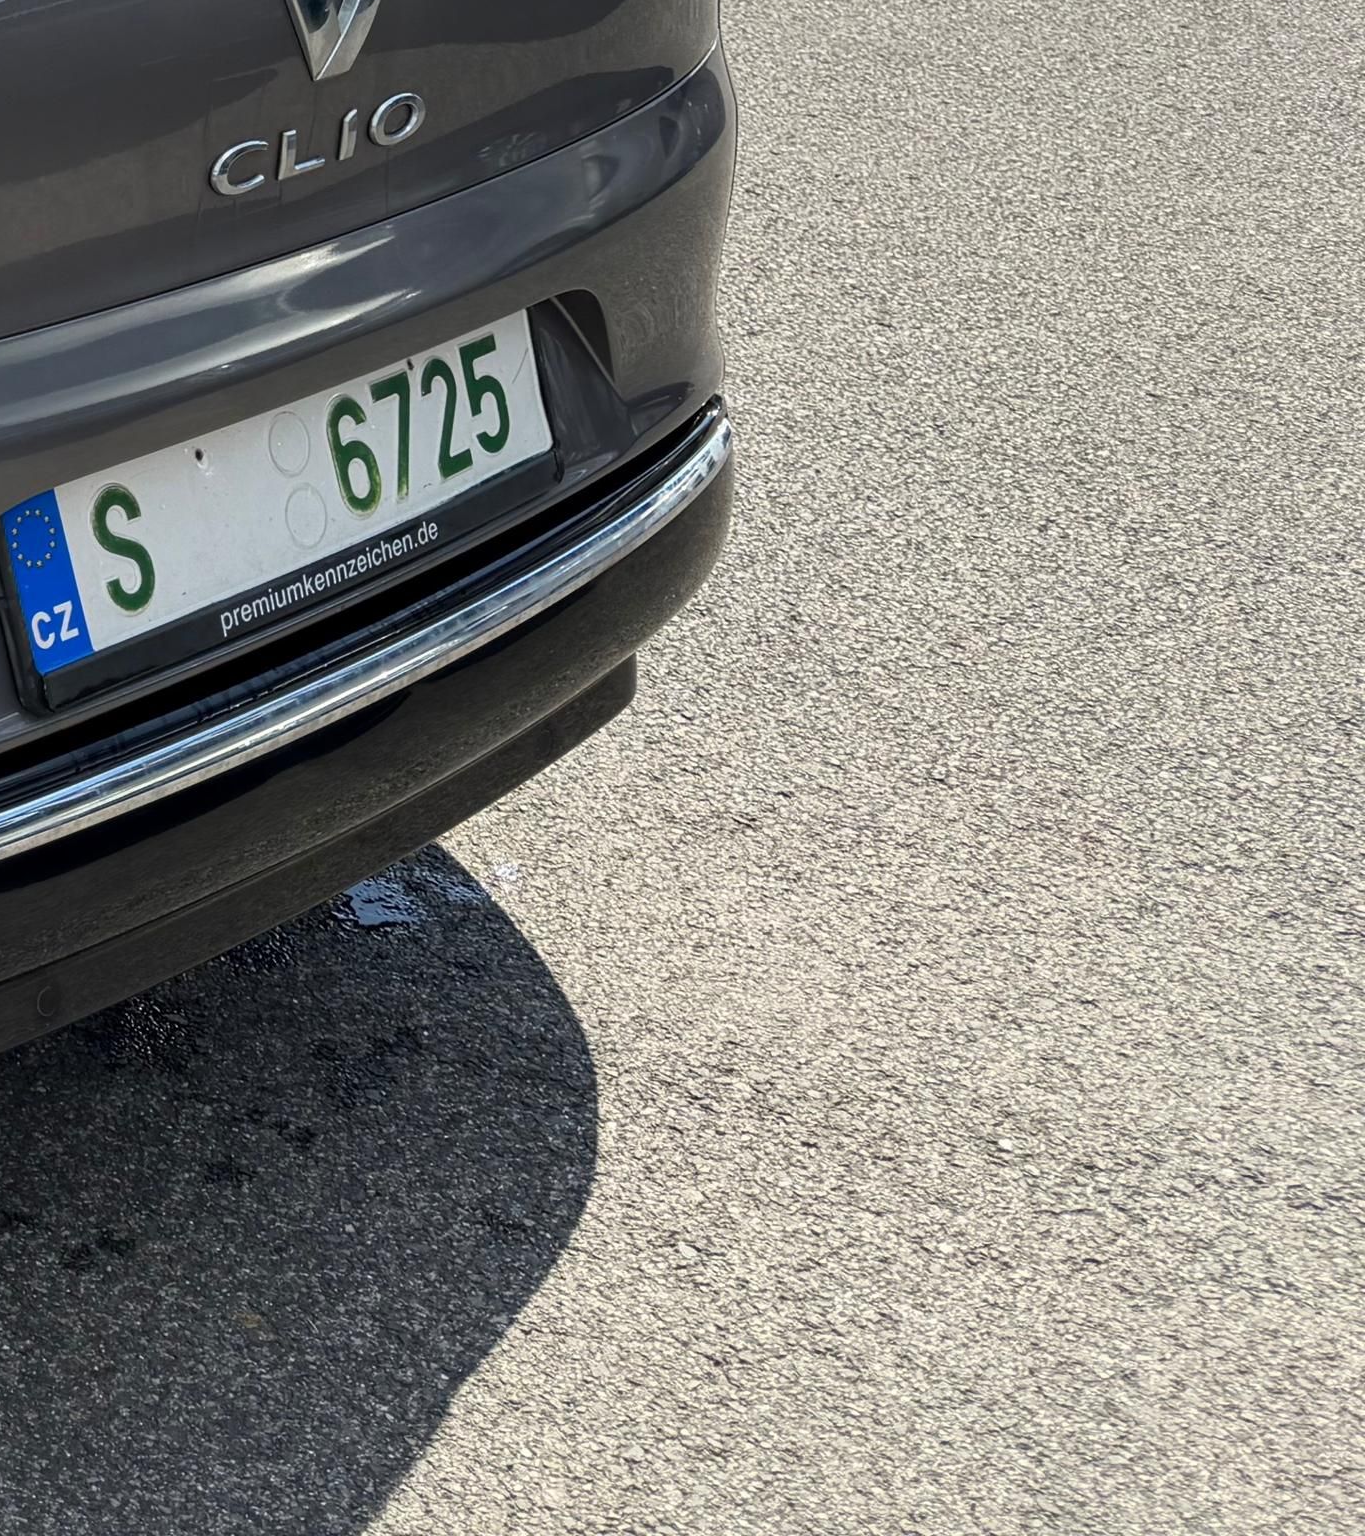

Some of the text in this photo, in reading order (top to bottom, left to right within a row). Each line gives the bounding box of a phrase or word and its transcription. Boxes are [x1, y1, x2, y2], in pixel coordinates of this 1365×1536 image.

[210, 92, 426, 195] CLIO
[90, 332, 510, 614] S 6725
[32, 600, 79, 649] CZ
[220, 520, 439, 638] premiumkennzeichen.de
